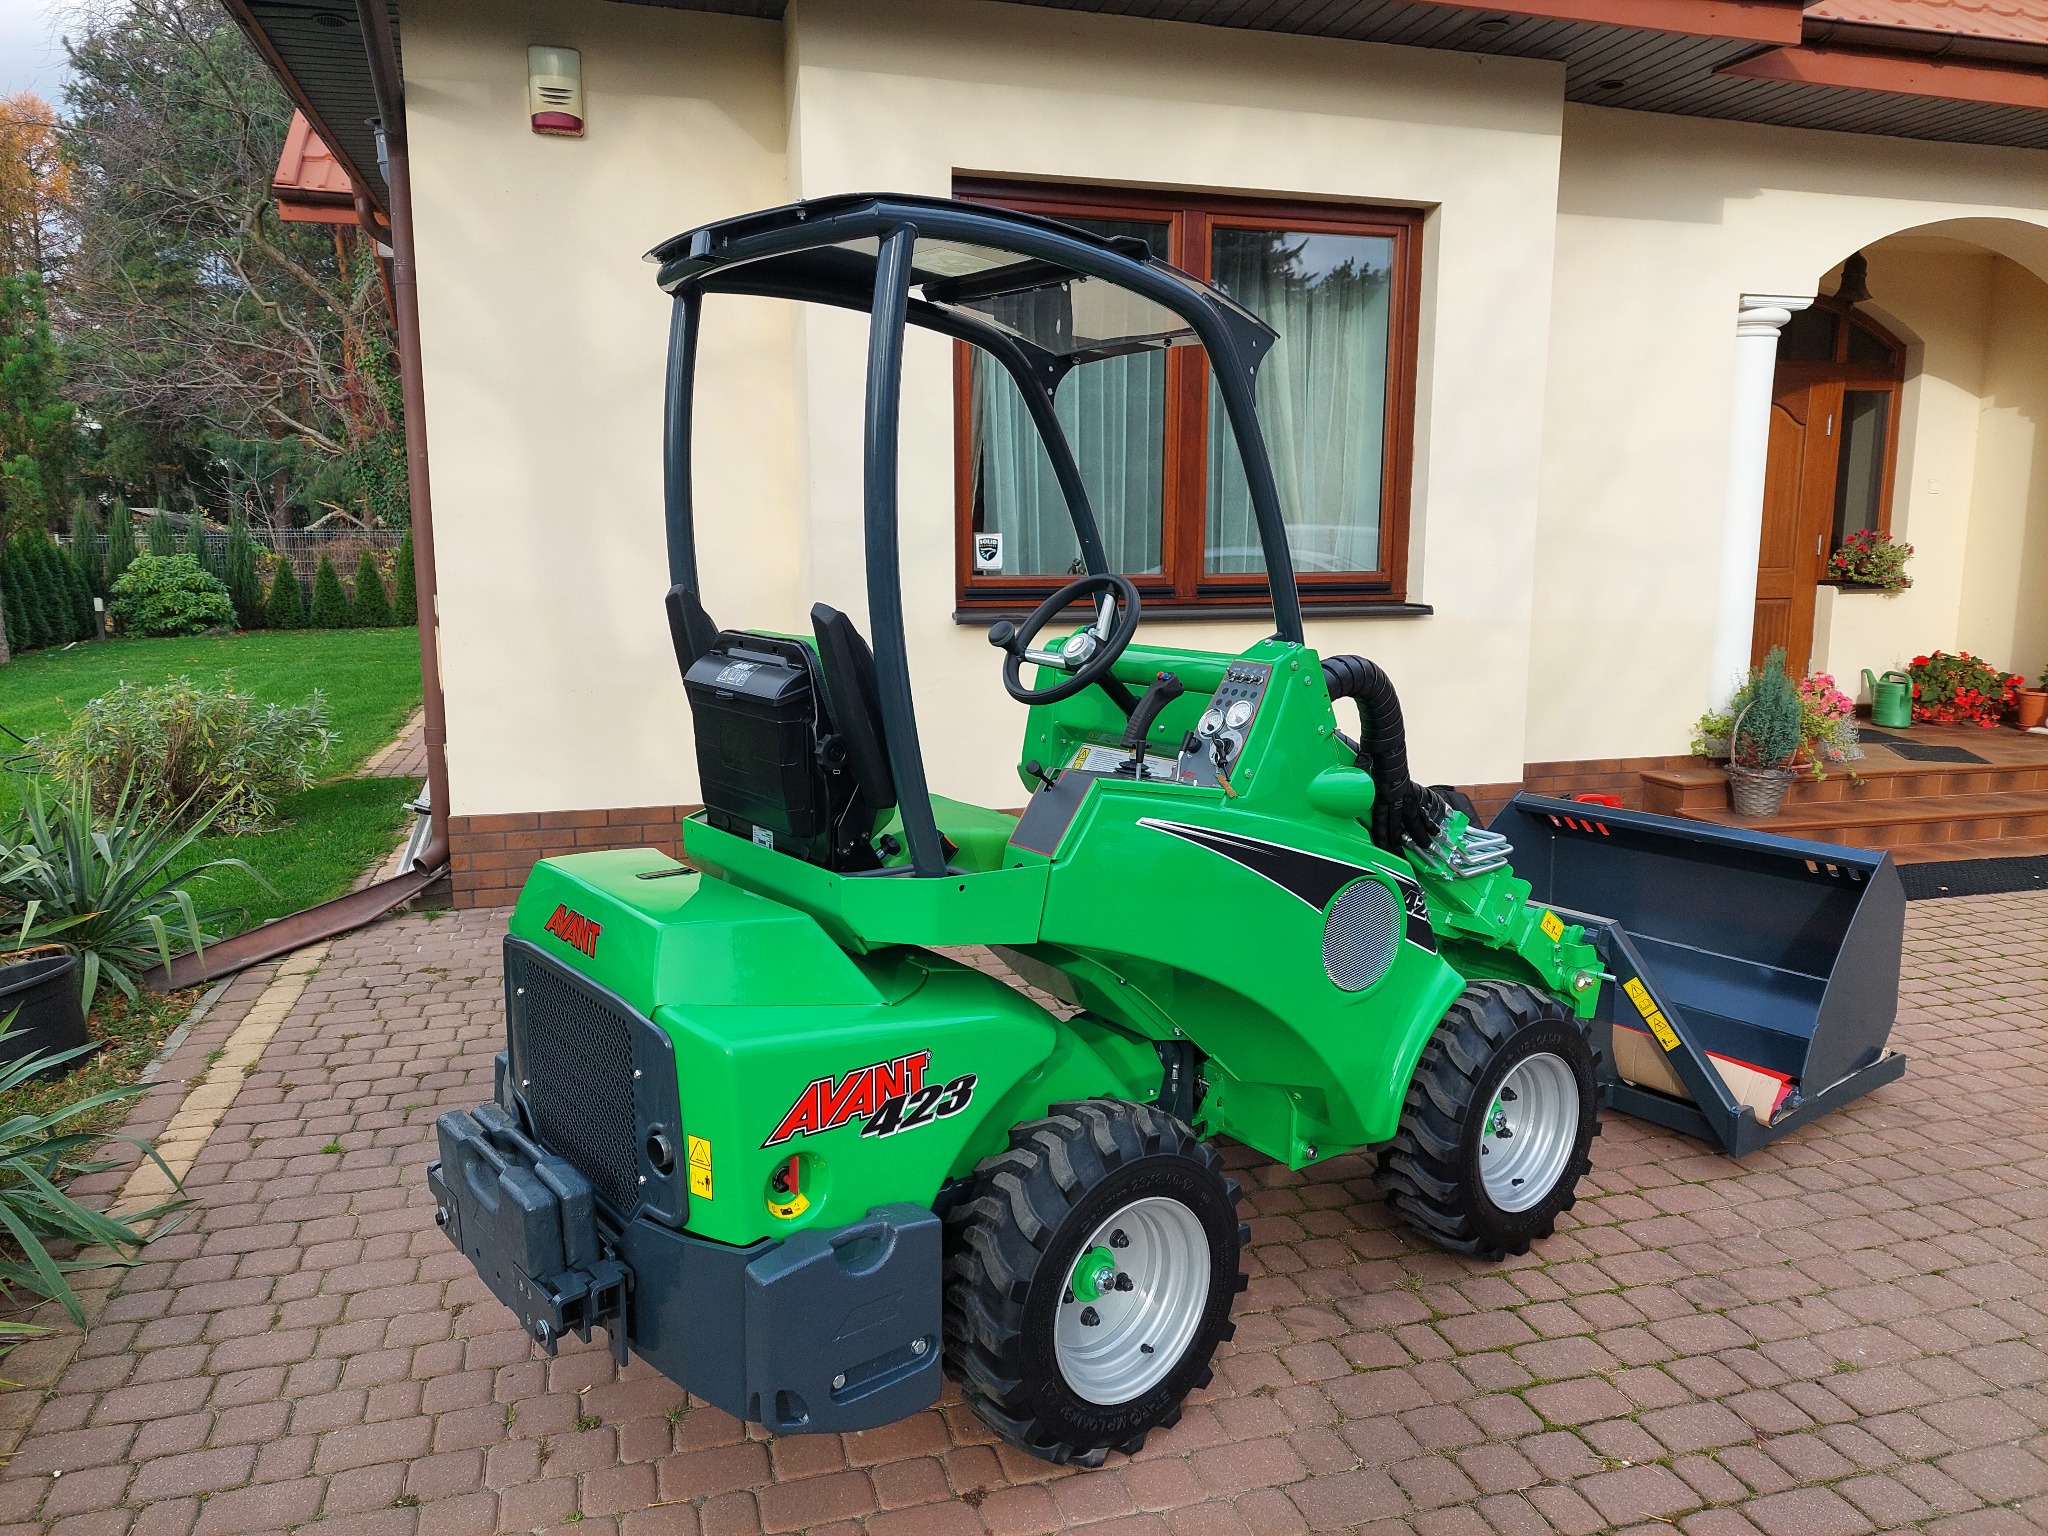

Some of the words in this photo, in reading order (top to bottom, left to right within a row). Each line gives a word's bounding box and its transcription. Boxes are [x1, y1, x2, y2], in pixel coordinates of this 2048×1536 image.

[544, 903, 601, 959] AVANT
[760, 1049, 929, 1149] AVANT
[860, 1073, 977, 1138] 423
